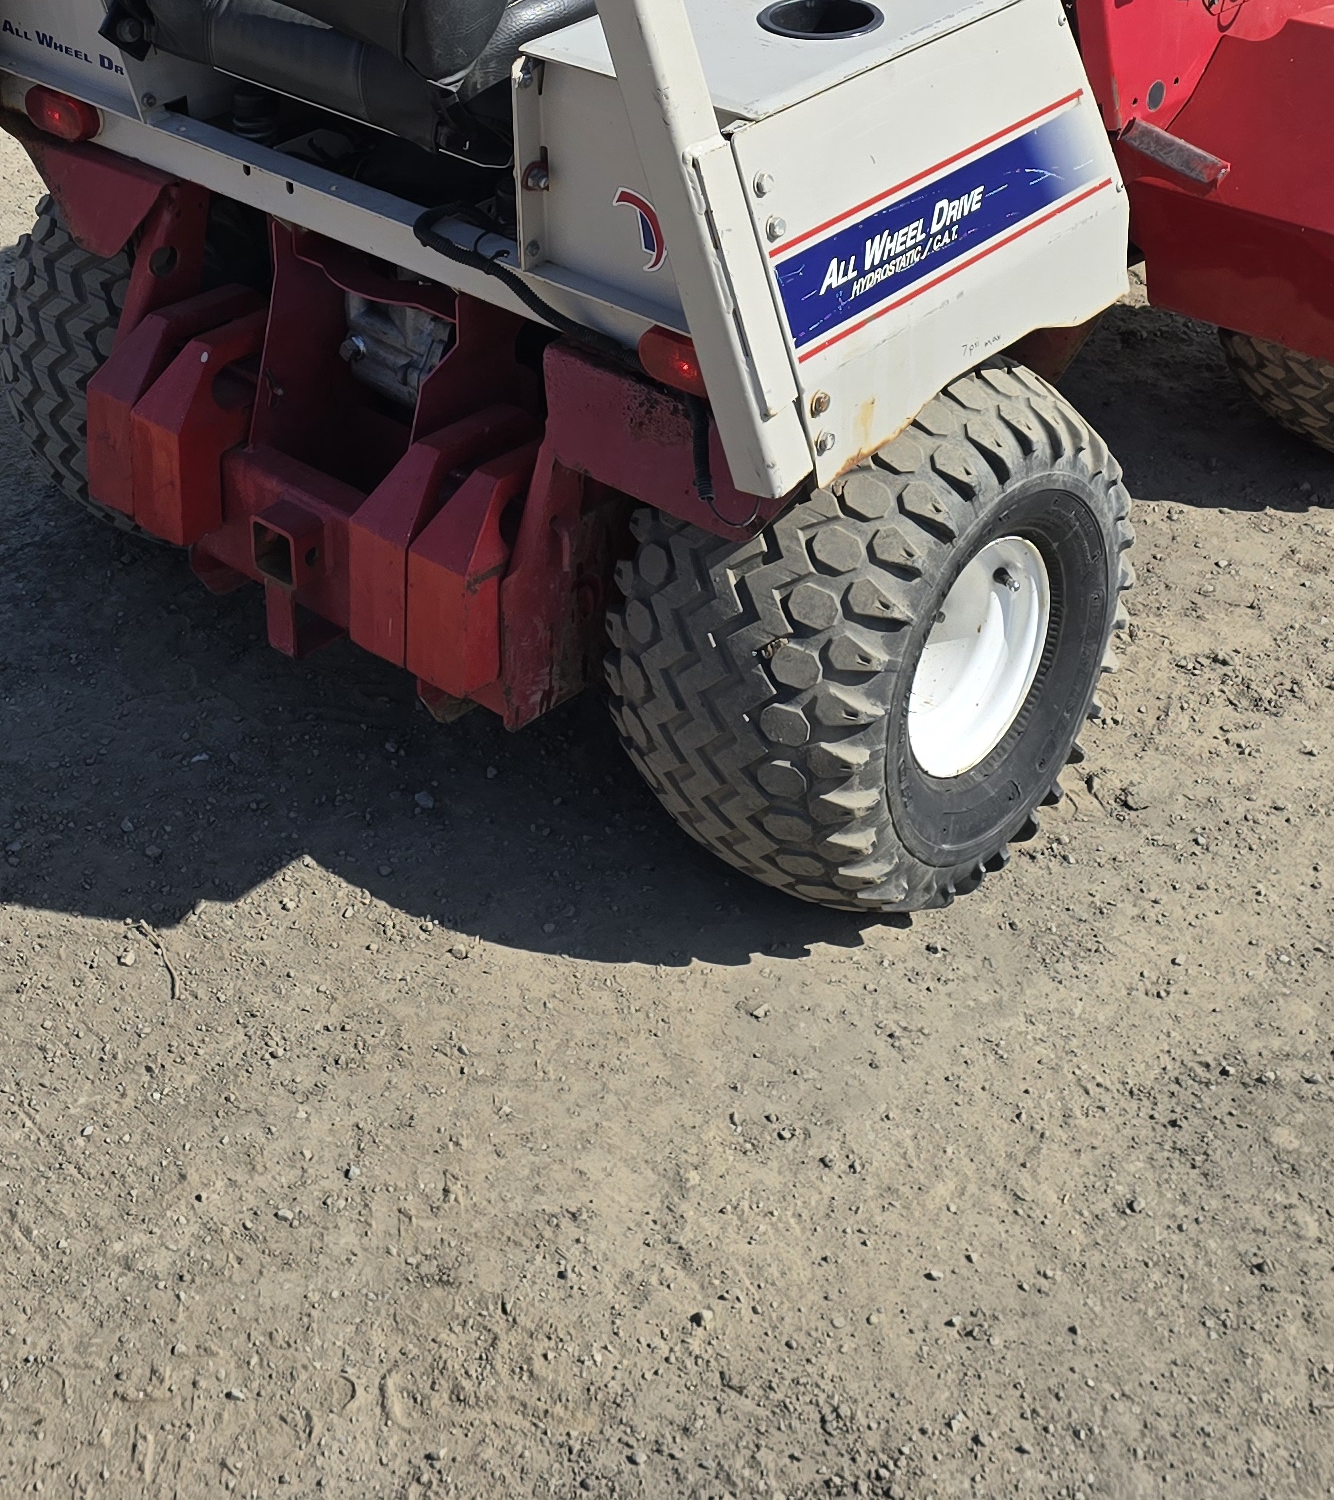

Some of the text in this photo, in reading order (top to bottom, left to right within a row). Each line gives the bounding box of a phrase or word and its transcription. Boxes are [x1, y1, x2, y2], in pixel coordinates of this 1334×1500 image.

[2, 19, 32, 41] ALL
[35, 30, 92, 63] WHEEL
[819, 185, 985, 296] ALL WHEEL DRIVE
